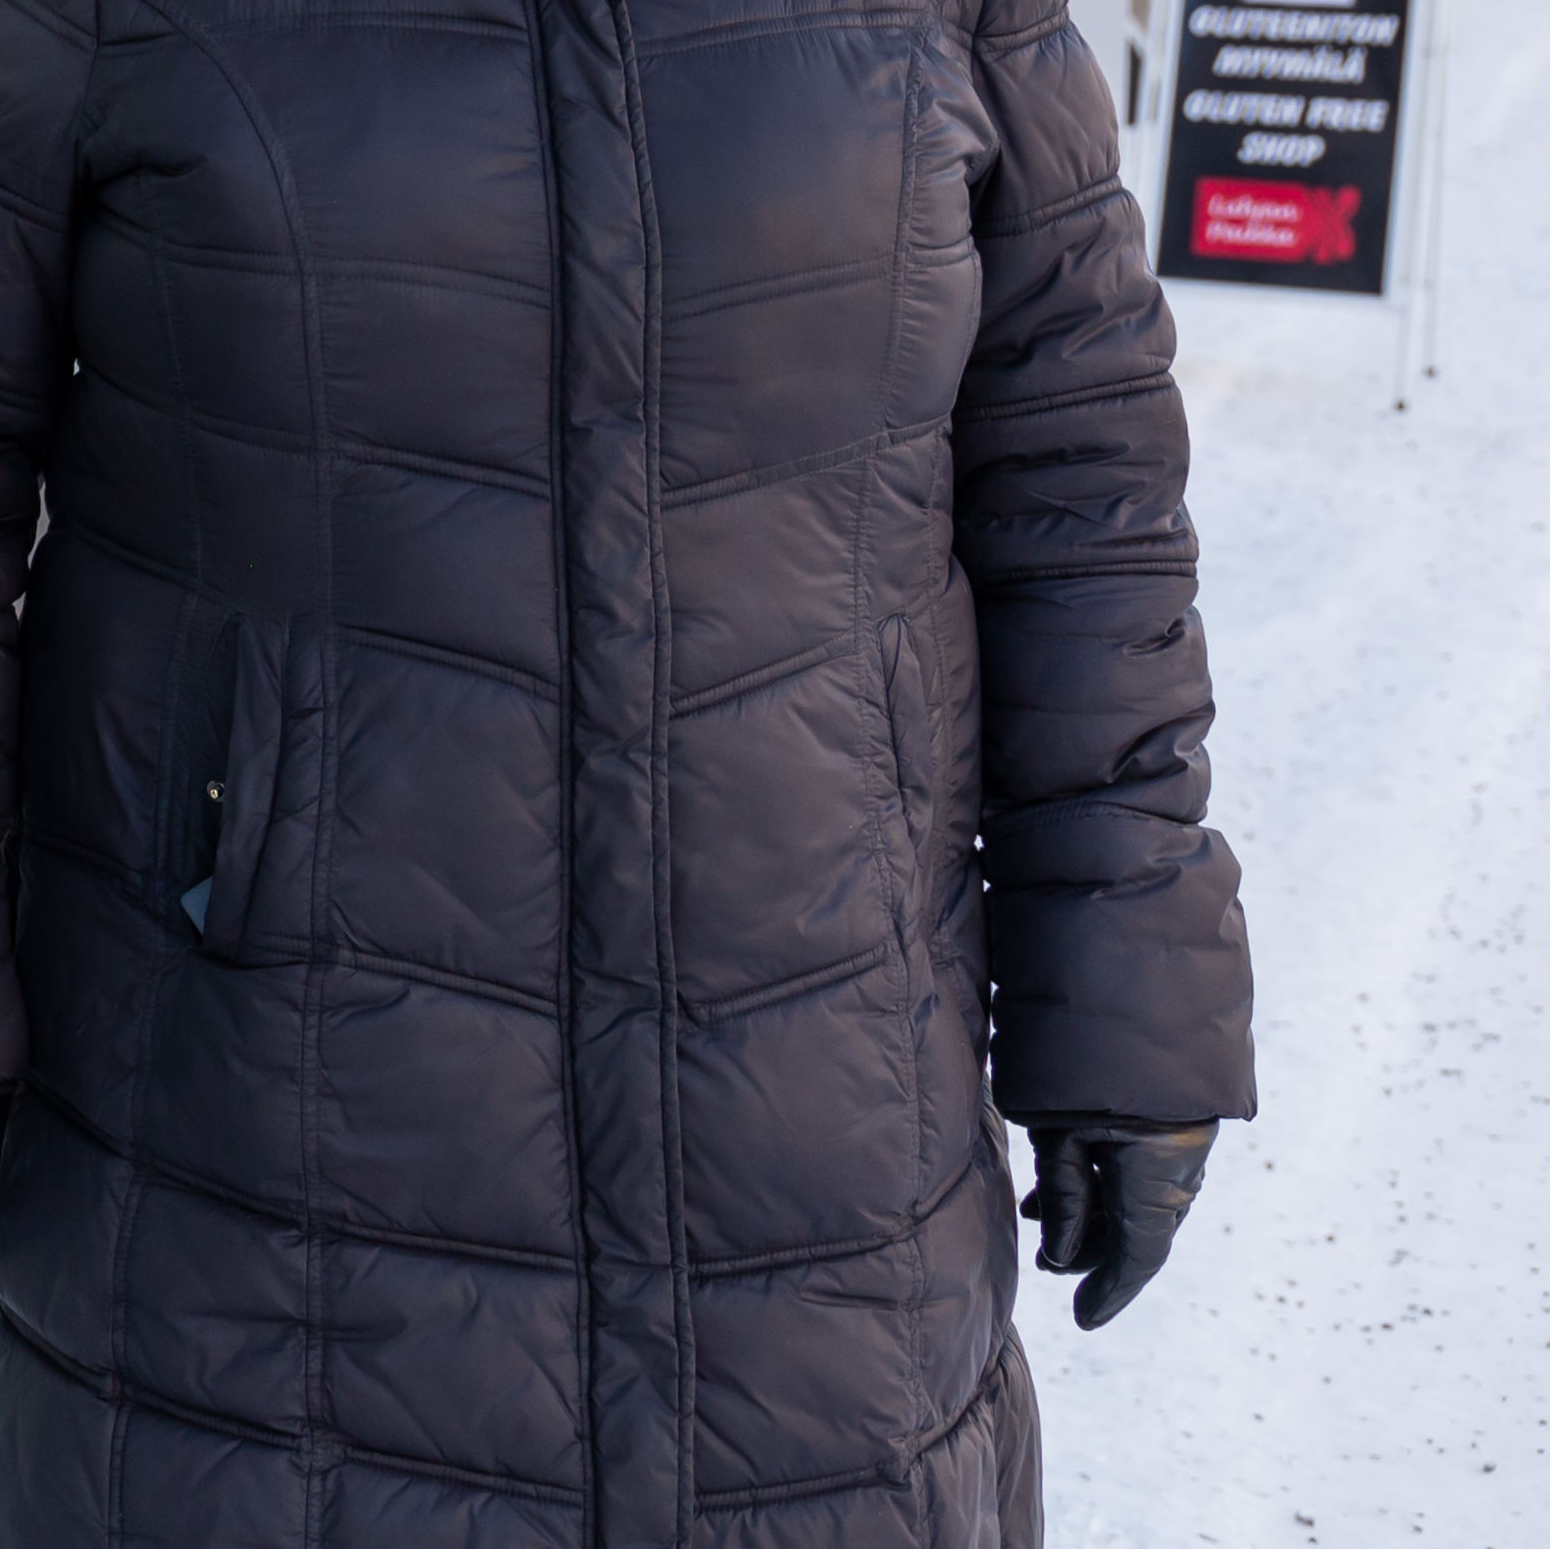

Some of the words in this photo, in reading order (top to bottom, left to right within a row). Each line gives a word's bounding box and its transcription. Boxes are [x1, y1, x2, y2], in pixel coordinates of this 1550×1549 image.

[1183, 88, 1305, 129] GLUTEN
[1305, 96, 1390, 133] FREE
[1236, 131, 1326, 168] SHOP
